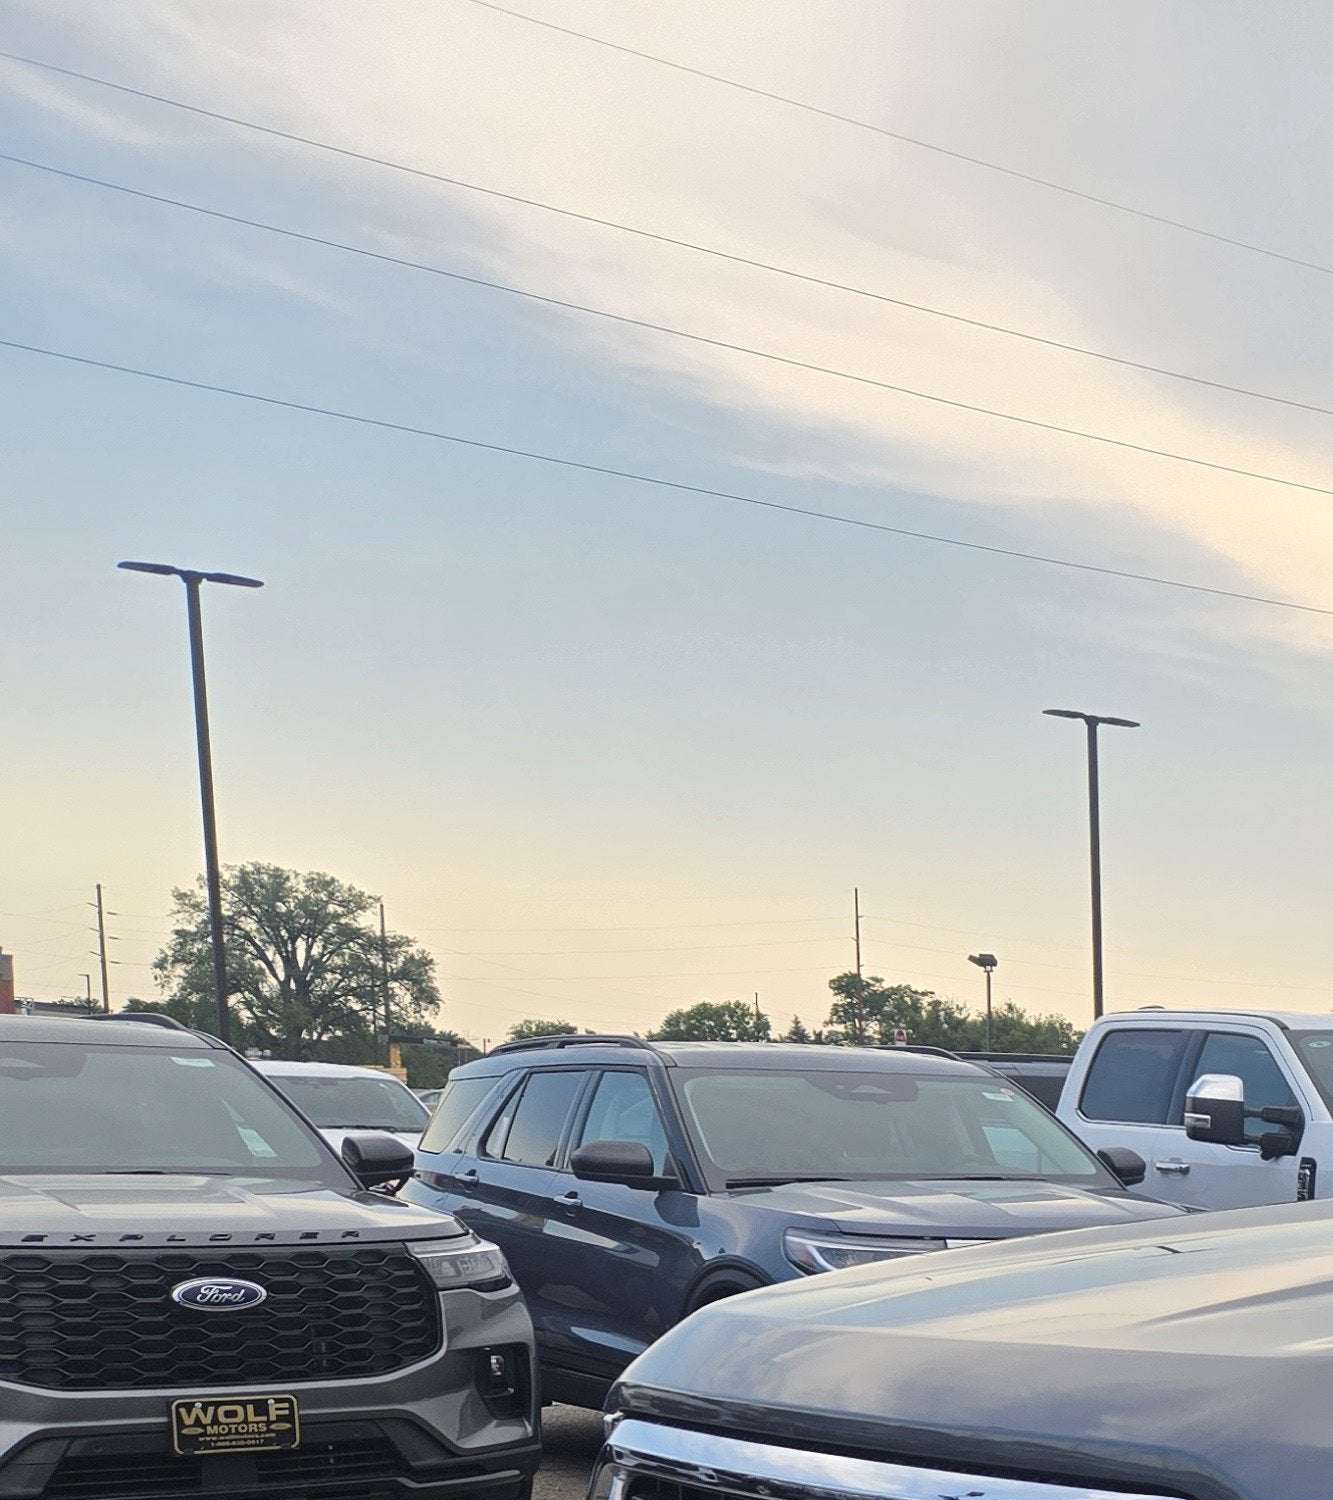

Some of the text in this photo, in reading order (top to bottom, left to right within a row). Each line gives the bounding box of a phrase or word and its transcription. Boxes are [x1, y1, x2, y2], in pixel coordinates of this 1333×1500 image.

[20, 1230, 361, 1243] EXPLORER
[195, 1284, 245, 1303] Ford
[178, 1402, 290, 1425] WOLF
[206, 1422, 268, 1435] MOTORS
